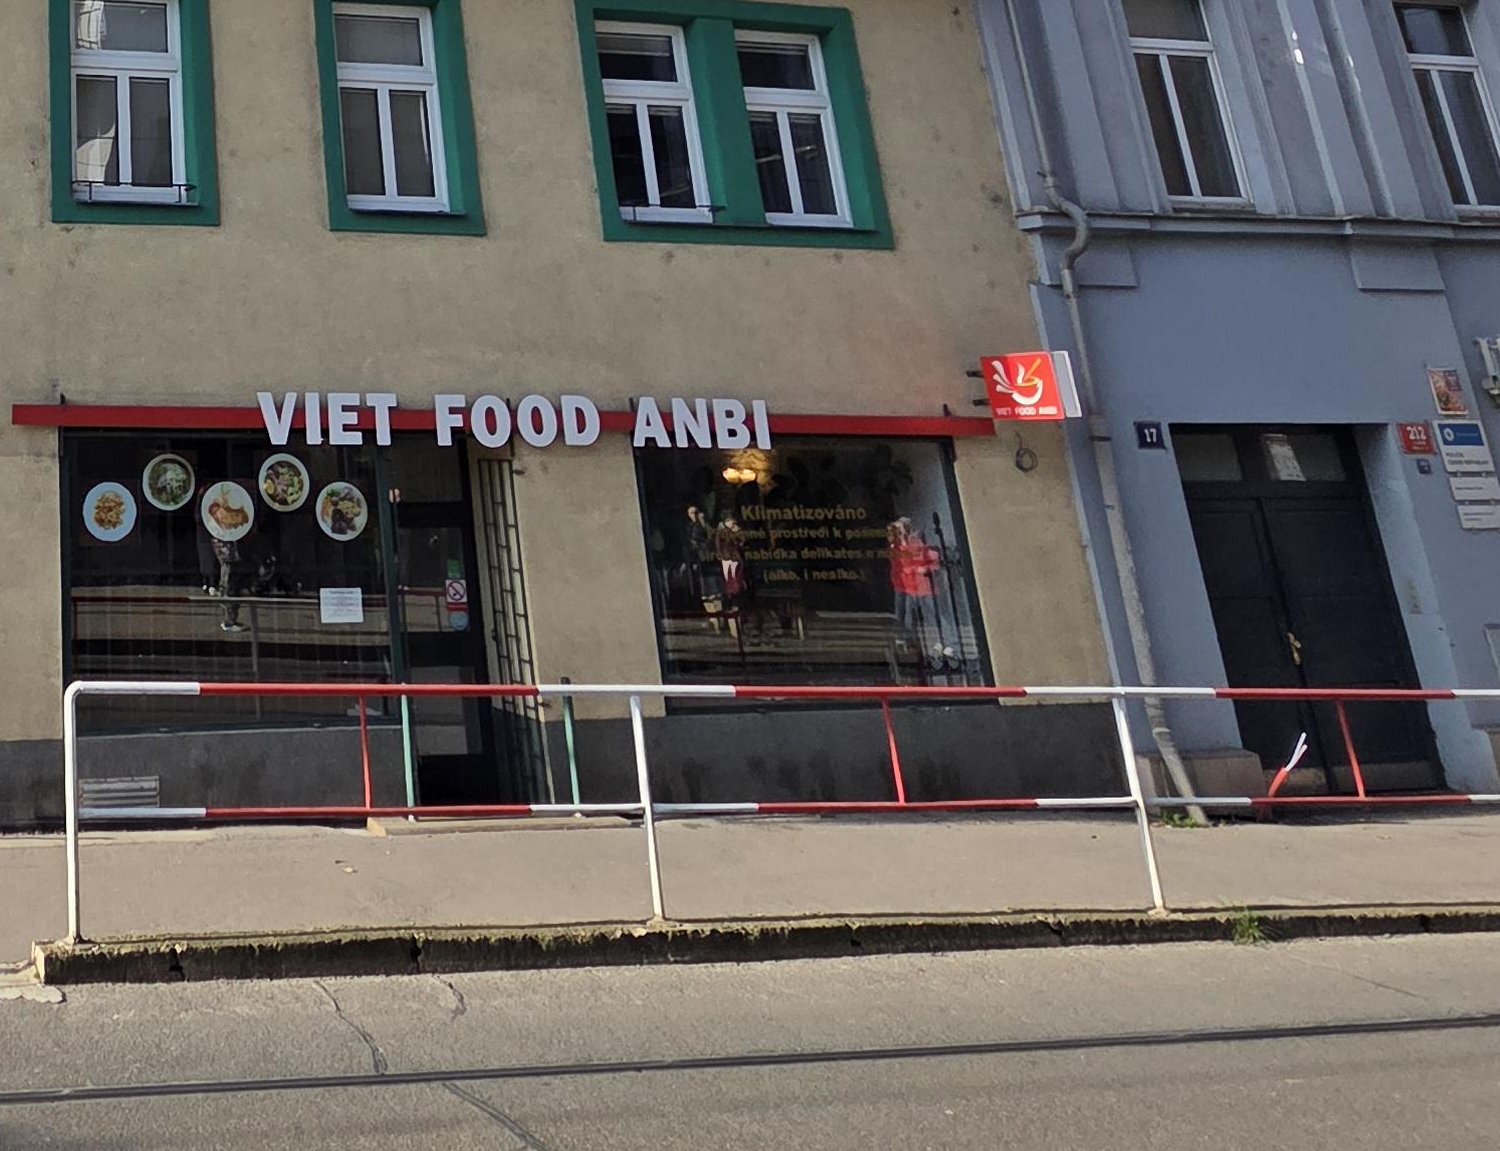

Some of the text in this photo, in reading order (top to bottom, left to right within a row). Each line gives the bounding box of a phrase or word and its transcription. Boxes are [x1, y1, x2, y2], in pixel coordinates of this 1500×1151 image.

[256, 391, 773, 449] VIET FOOD ANBI
[1144, 427, 1158, 443] 17
[1406, 425, 1427, 440] 212
[741, 504, 868, 520] Klimatizováno
